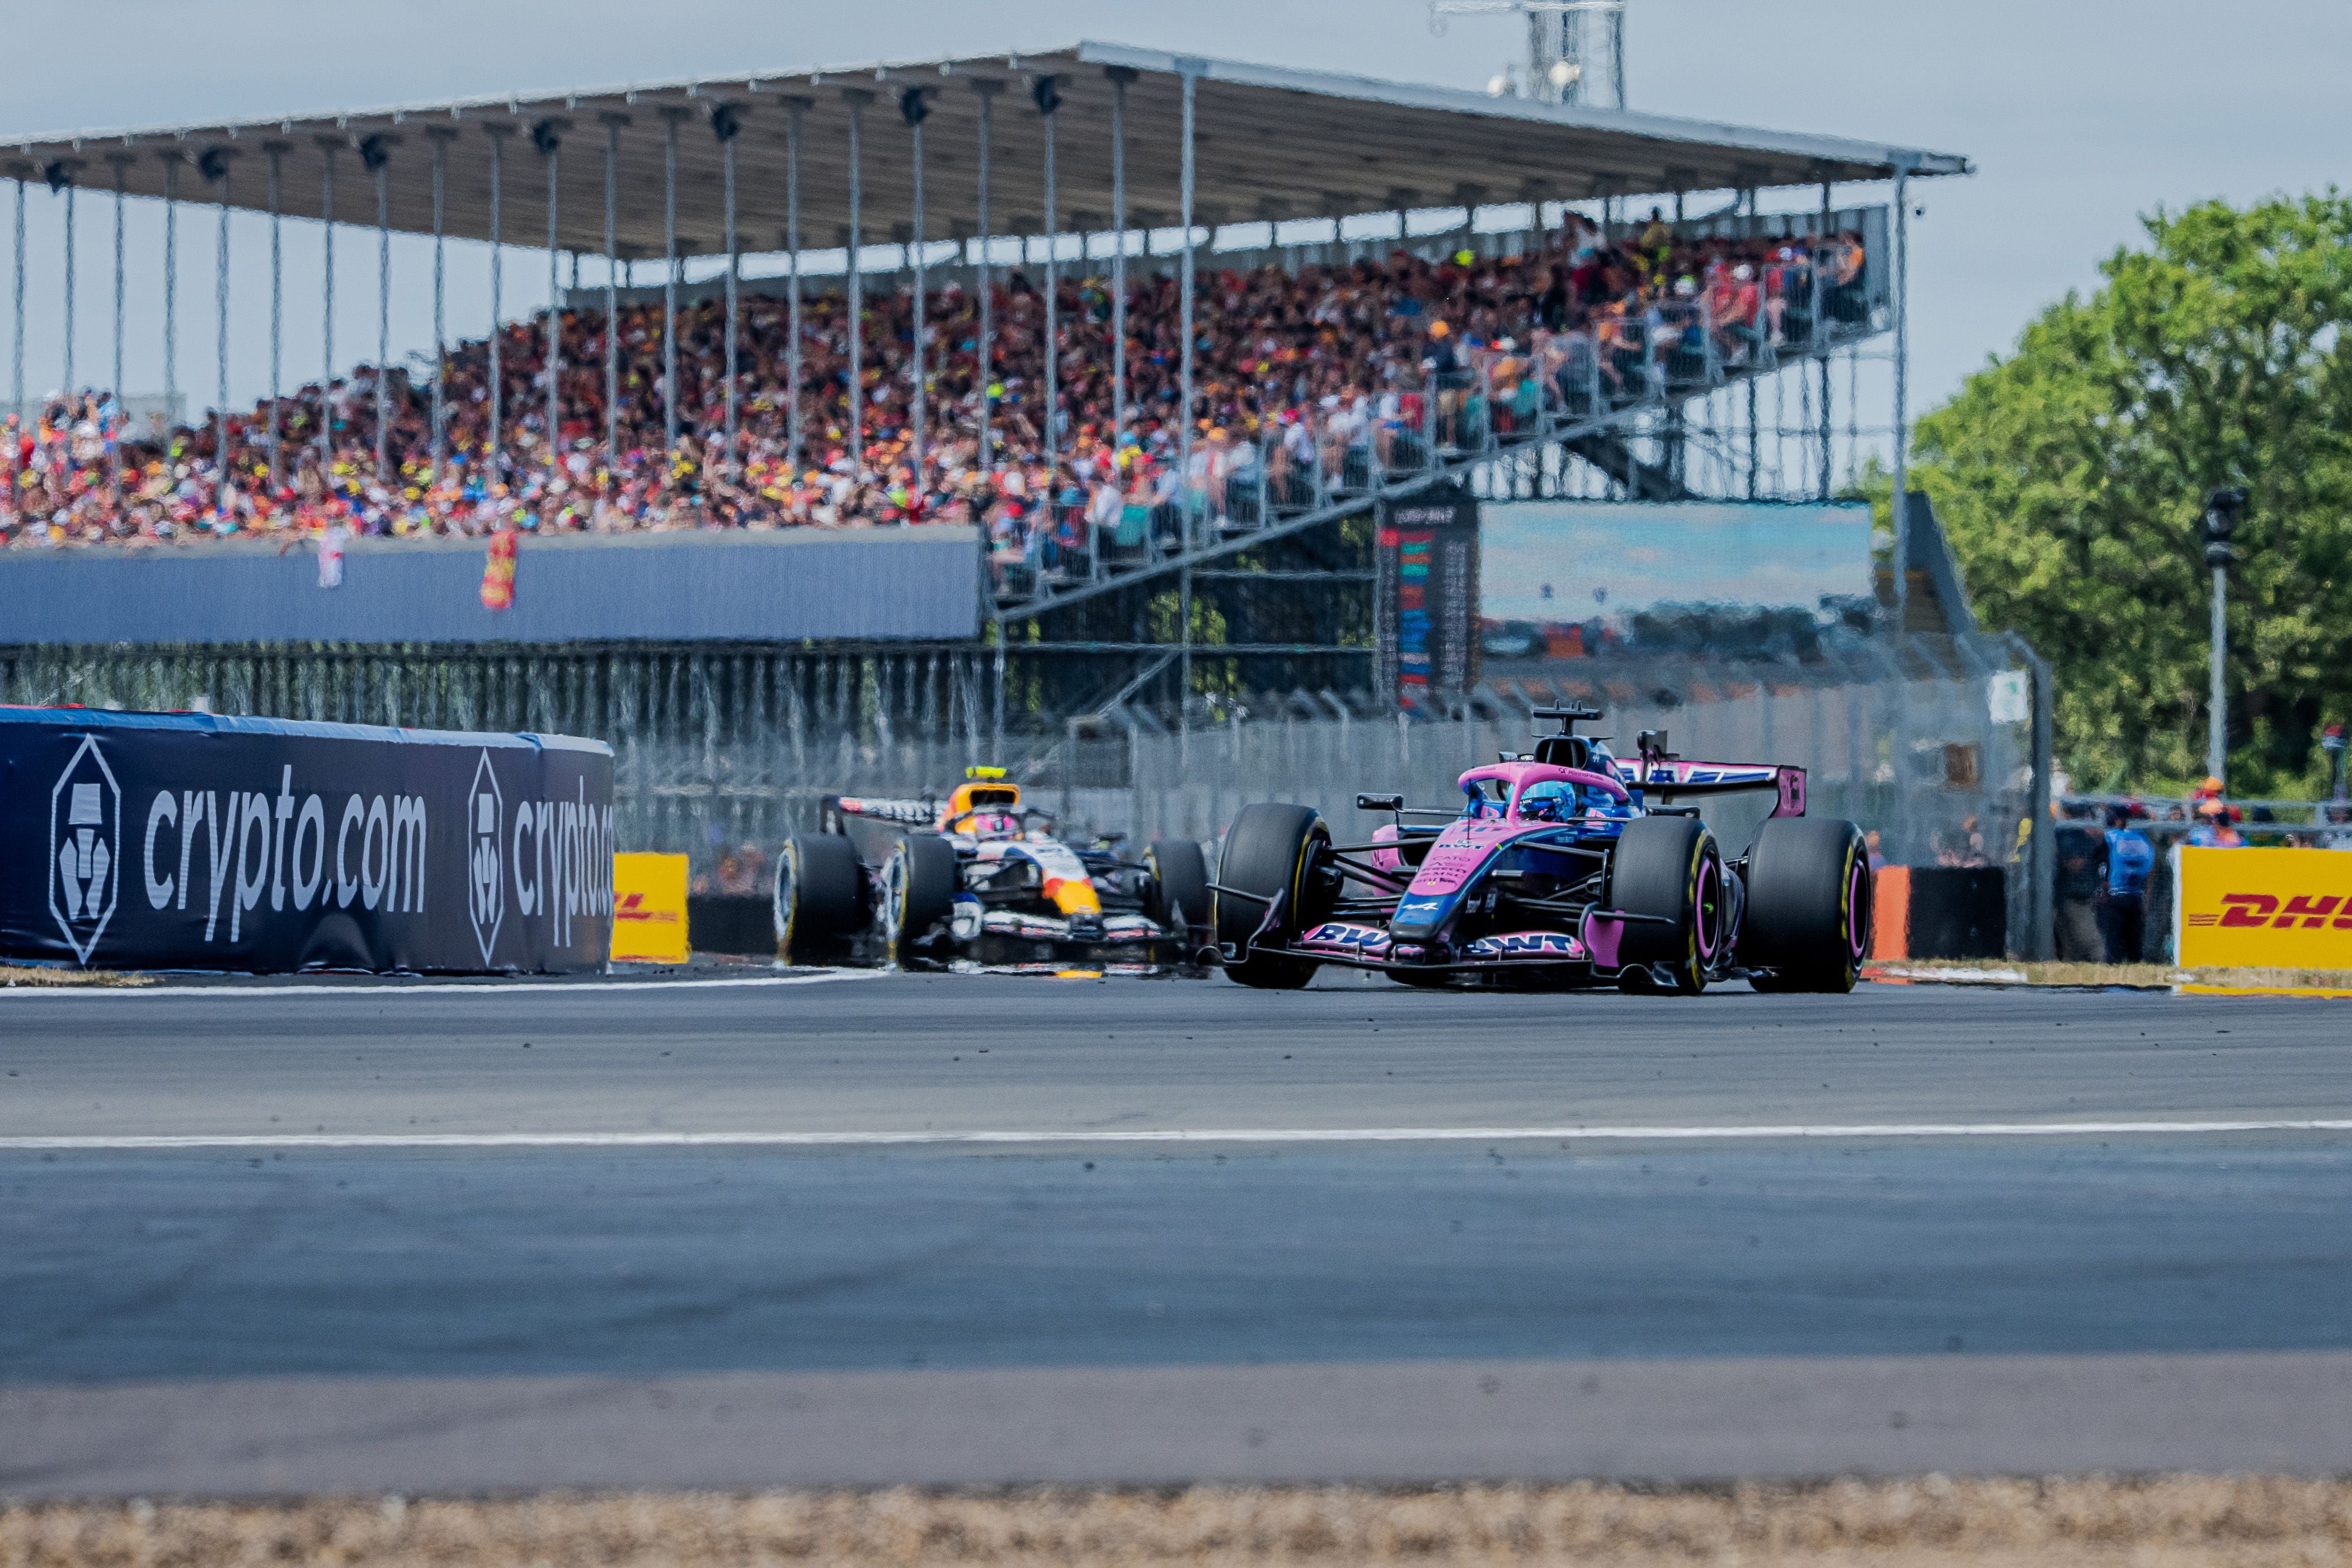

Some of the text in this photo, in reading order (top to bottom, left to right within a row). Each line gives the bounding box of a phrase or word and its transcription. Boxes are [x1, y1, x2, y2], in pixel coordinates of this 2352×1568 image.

[144, 764, 426, 942] crypto.com
[1308, 924, 1391, 947] BW
[1464, 934, 1574, 954] BWT
